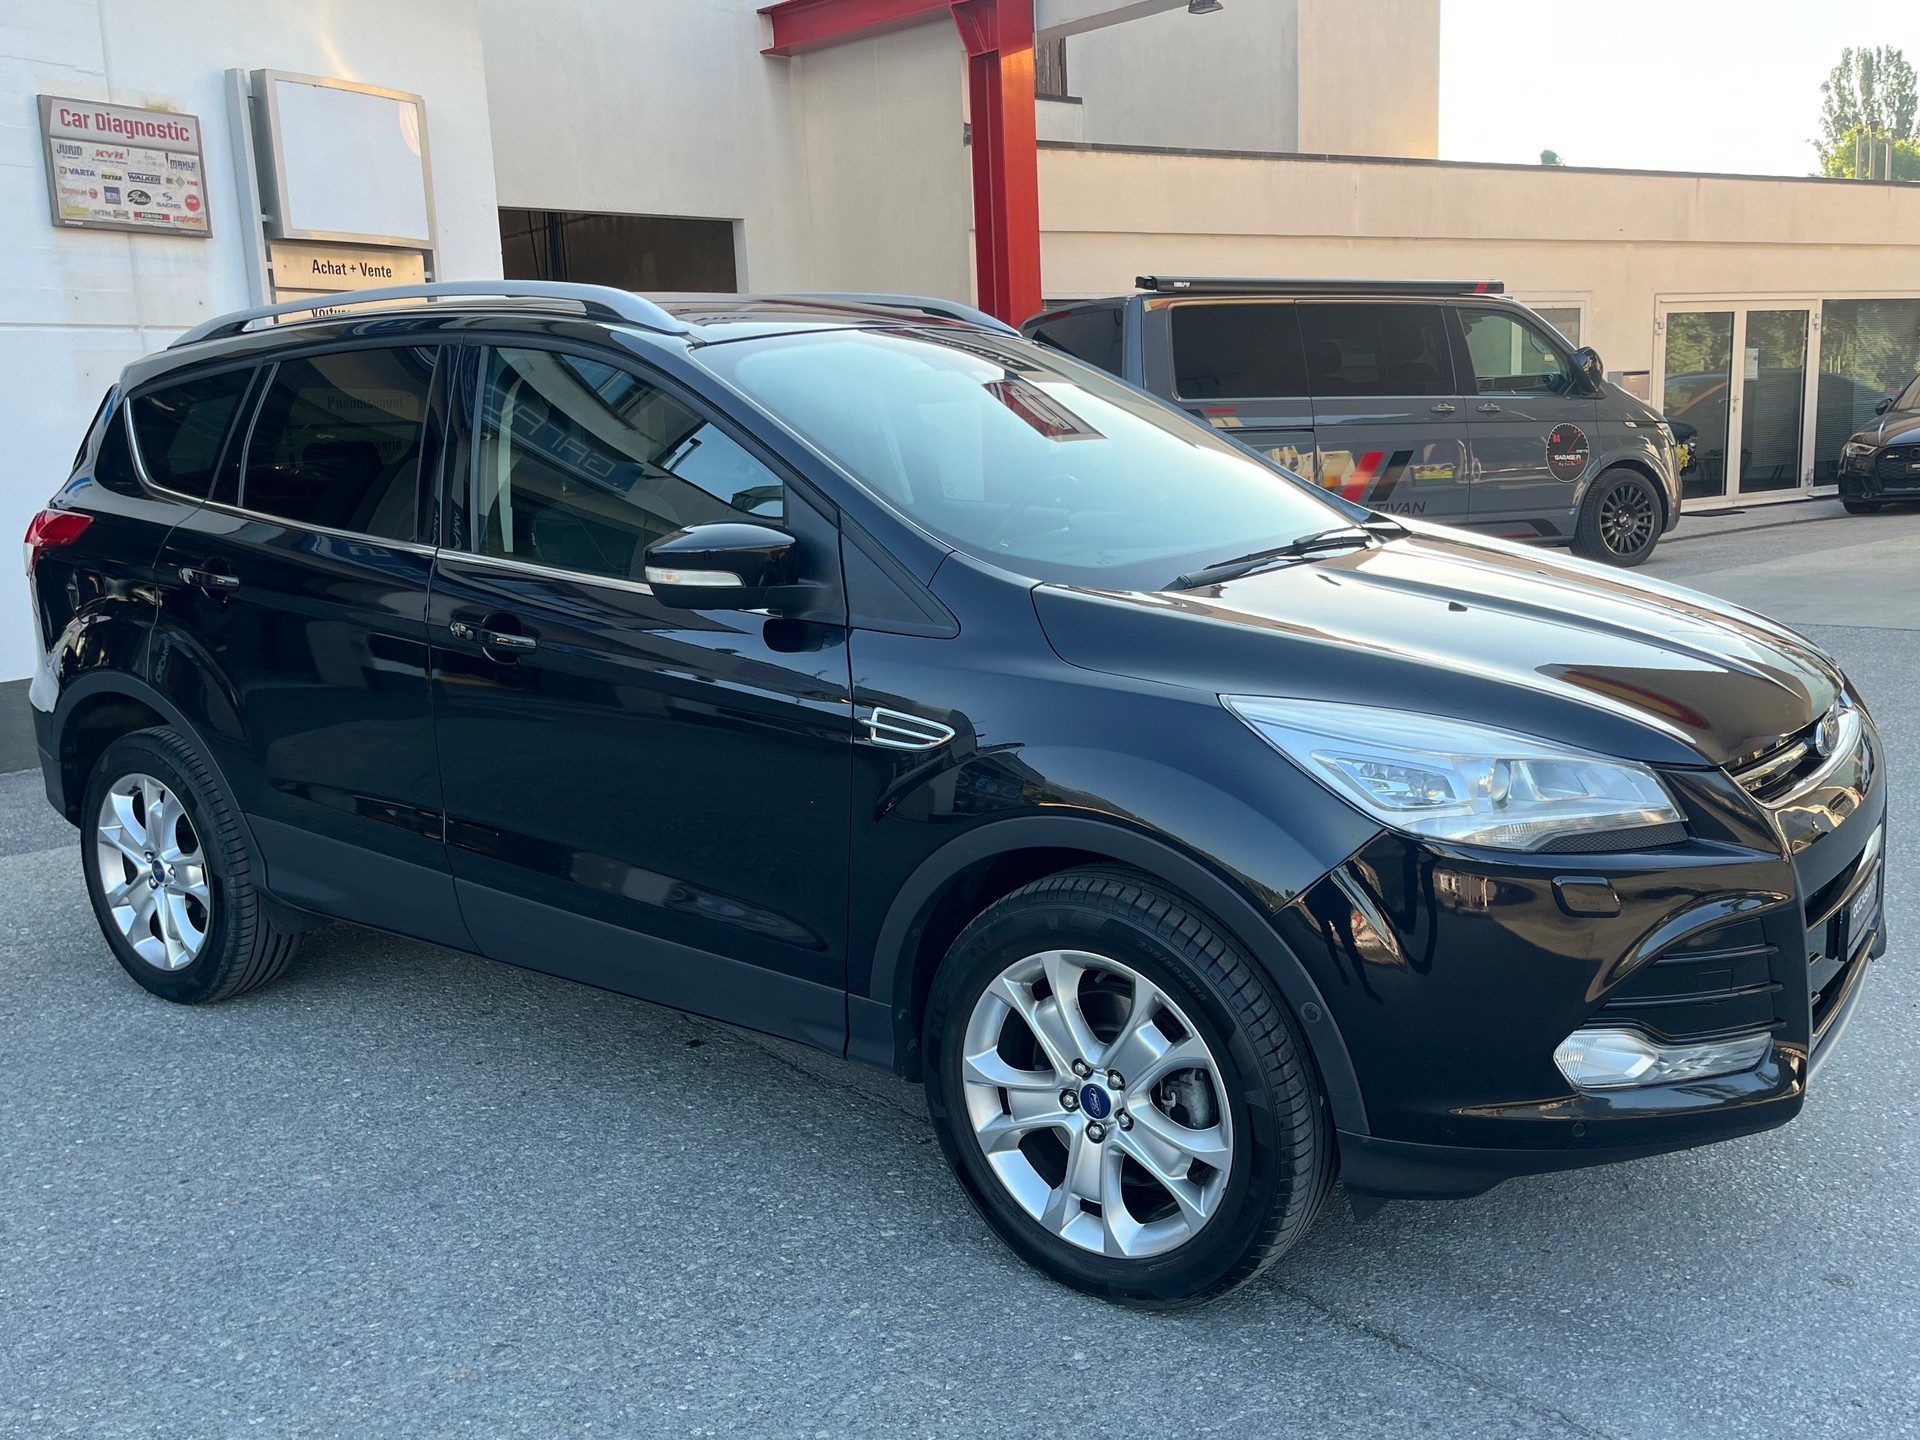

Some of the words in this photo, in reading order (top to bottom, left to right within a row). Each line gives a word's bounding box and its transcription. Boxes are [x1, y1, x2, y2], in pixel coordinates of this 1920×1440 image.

[60, 108, 91, 130] Car
[95, 112, 190, 141] Diagnostic
[56, 144, 83, 156] JURID
[170, 159, 197, 169] MAHLE
[68, 167, 96, 177] VARTA
[101, 173, 123, 181] TEXTAR
[129, 174, 161, 183] WALKER
[312, 259, 347, 276] Achat
[350, 265, 357, 273] +
[359, 262, 392, 278] Vente
[311, 308, 350, 317] Voit
